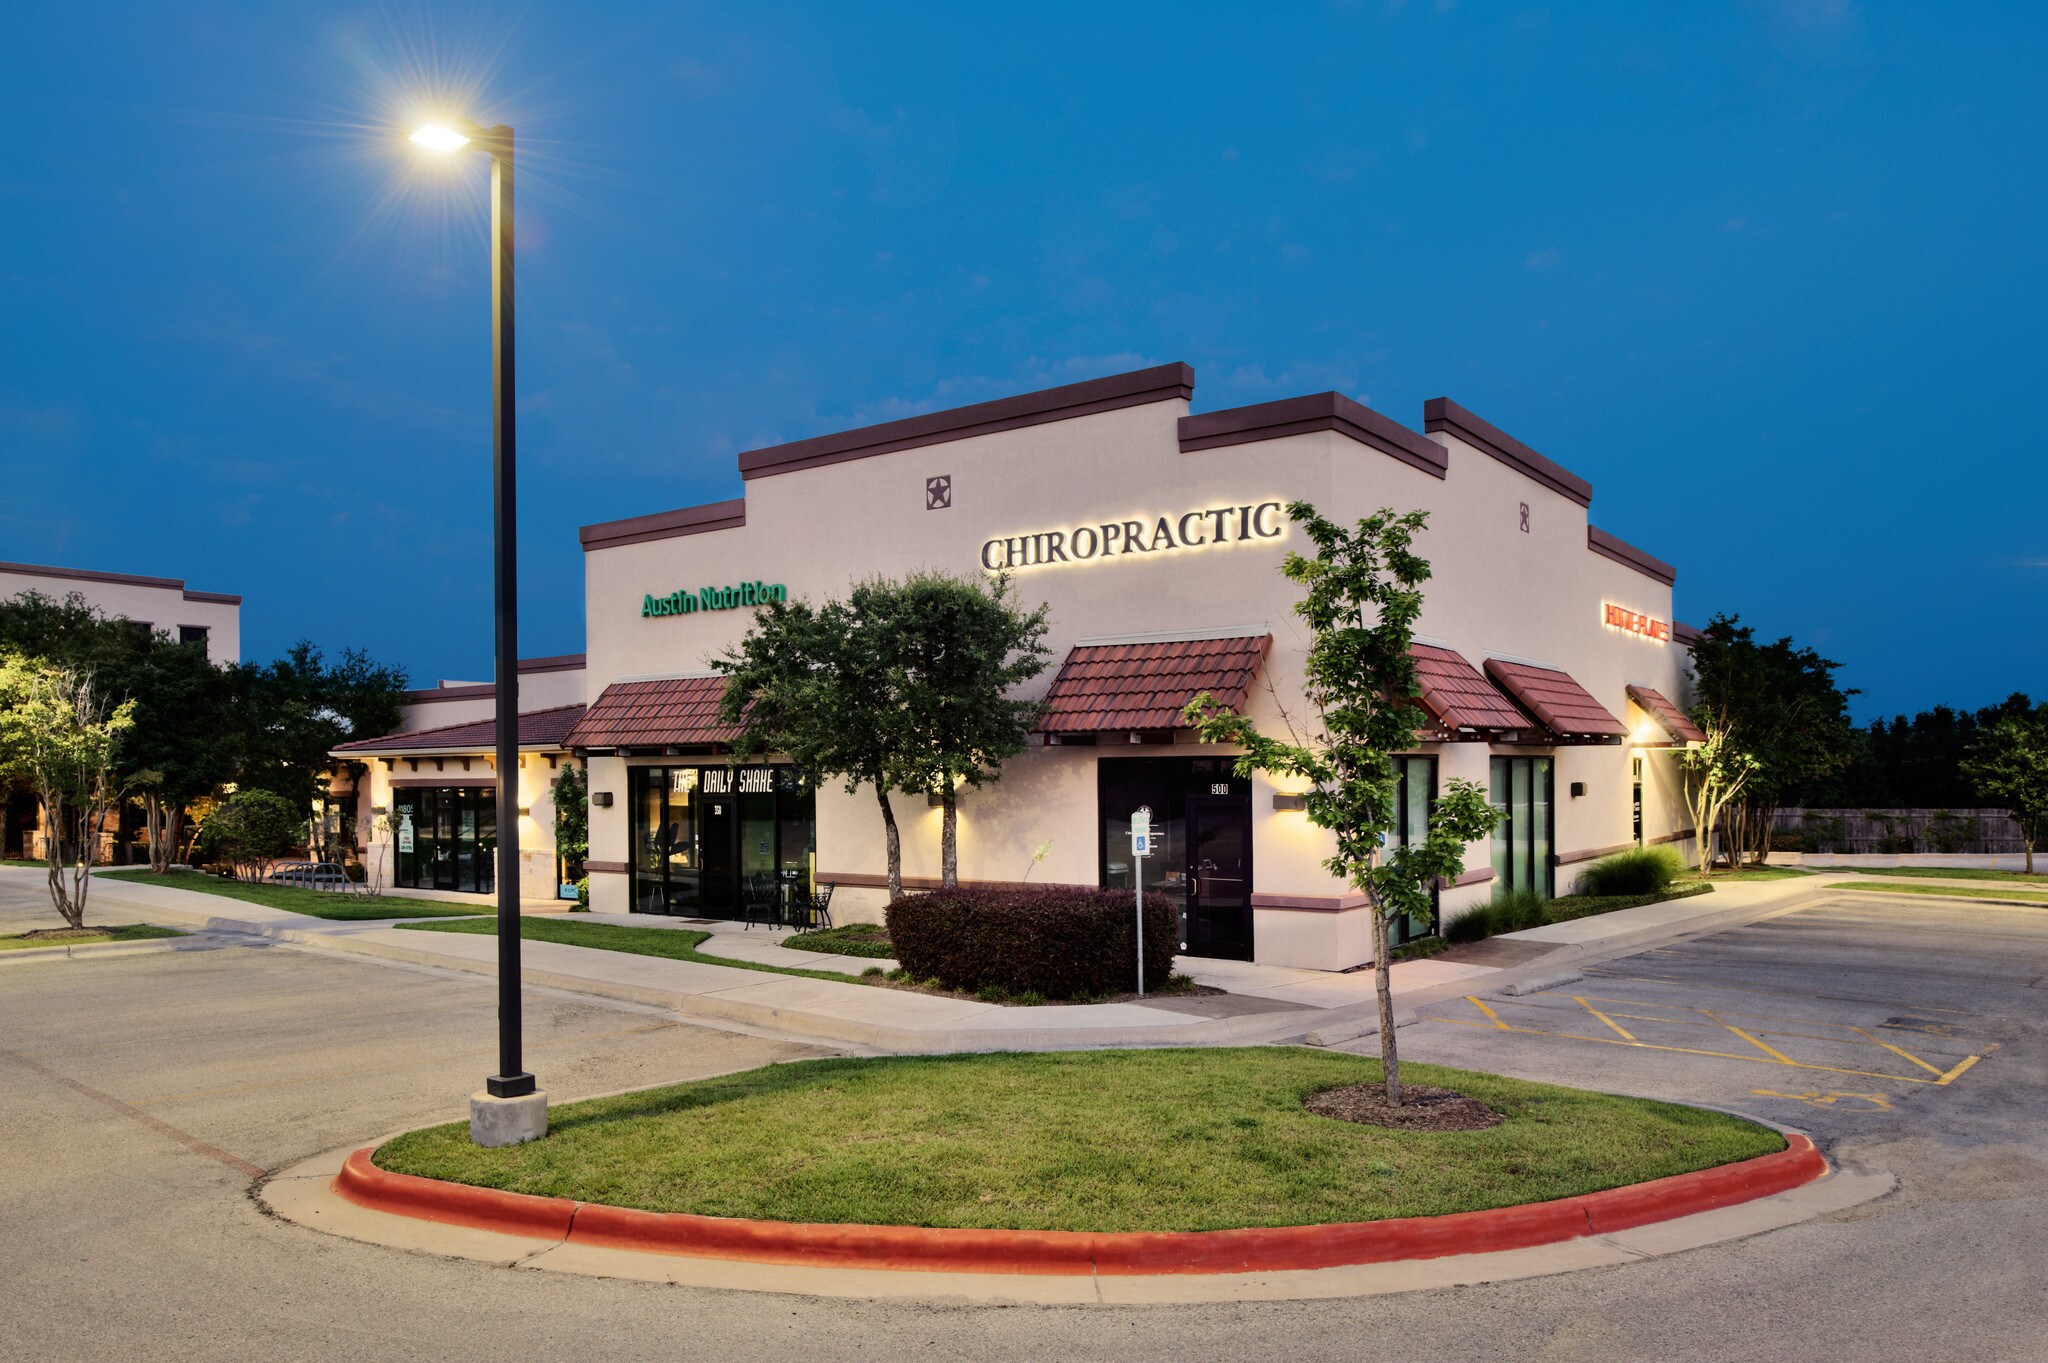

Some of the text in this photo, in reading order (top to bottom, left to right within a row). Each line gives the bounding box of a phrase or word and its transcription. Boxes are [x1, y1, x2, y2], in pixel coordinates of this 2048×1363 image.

[981, 502, 1283, 571] CHIROPRACTIC
[641, 580, 787, 617] Austin Nutrition
[703, 770, 733, 793] DAILY
[739, 769, 774, 793] SHAKE
[1212, 784, 1228, 794] 500
